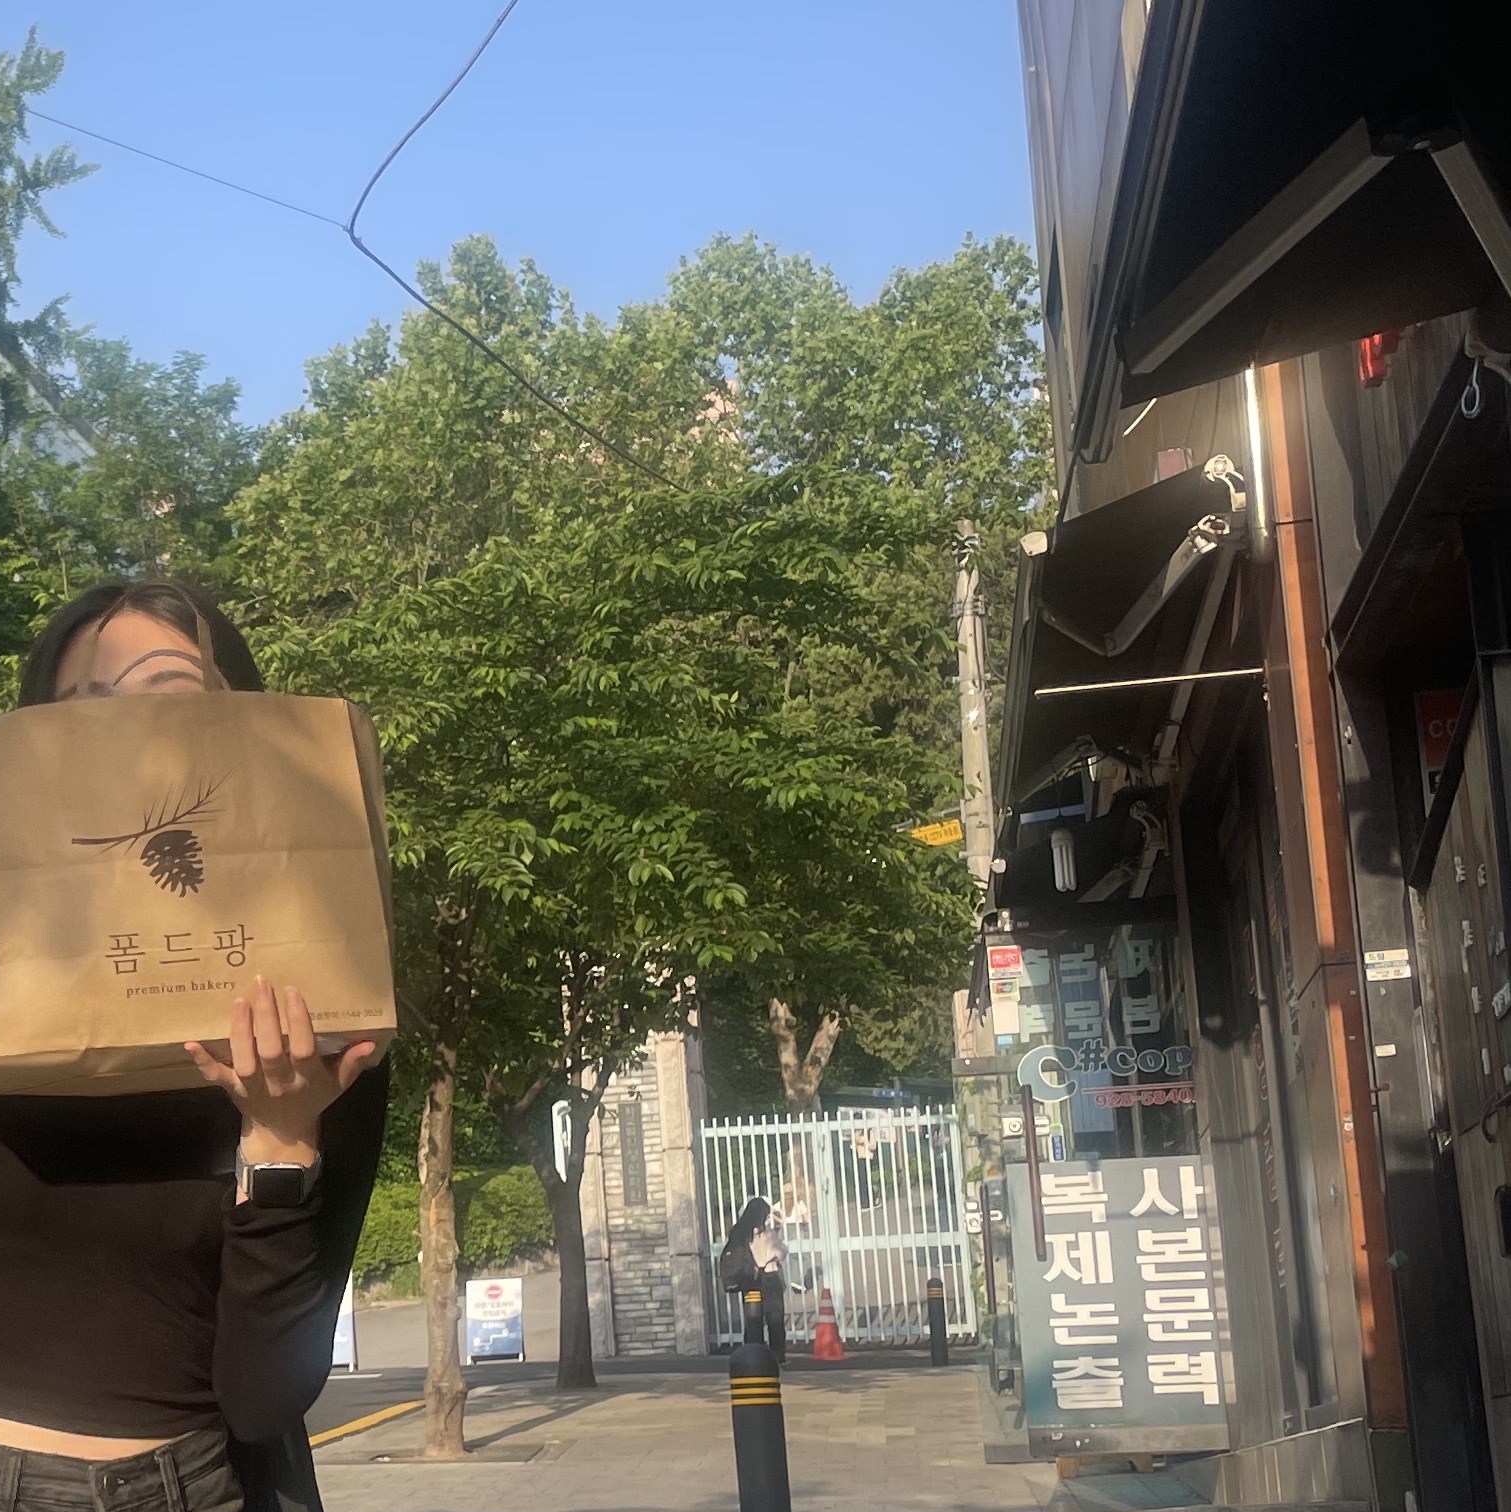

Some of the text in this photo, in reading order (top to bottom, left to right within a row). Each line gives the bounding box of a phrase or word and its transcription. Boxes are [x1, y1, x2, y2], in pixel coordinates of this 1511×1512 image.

[126, 977, 238, 998] premium bakery
[1041, 1166, 1204, 1224] 복사
[1042, 1227, 1207, 1285] 제본
[1049, 1288, 1214, 1346] 논문
[1052, 1351, 1220, 1410] 출력
